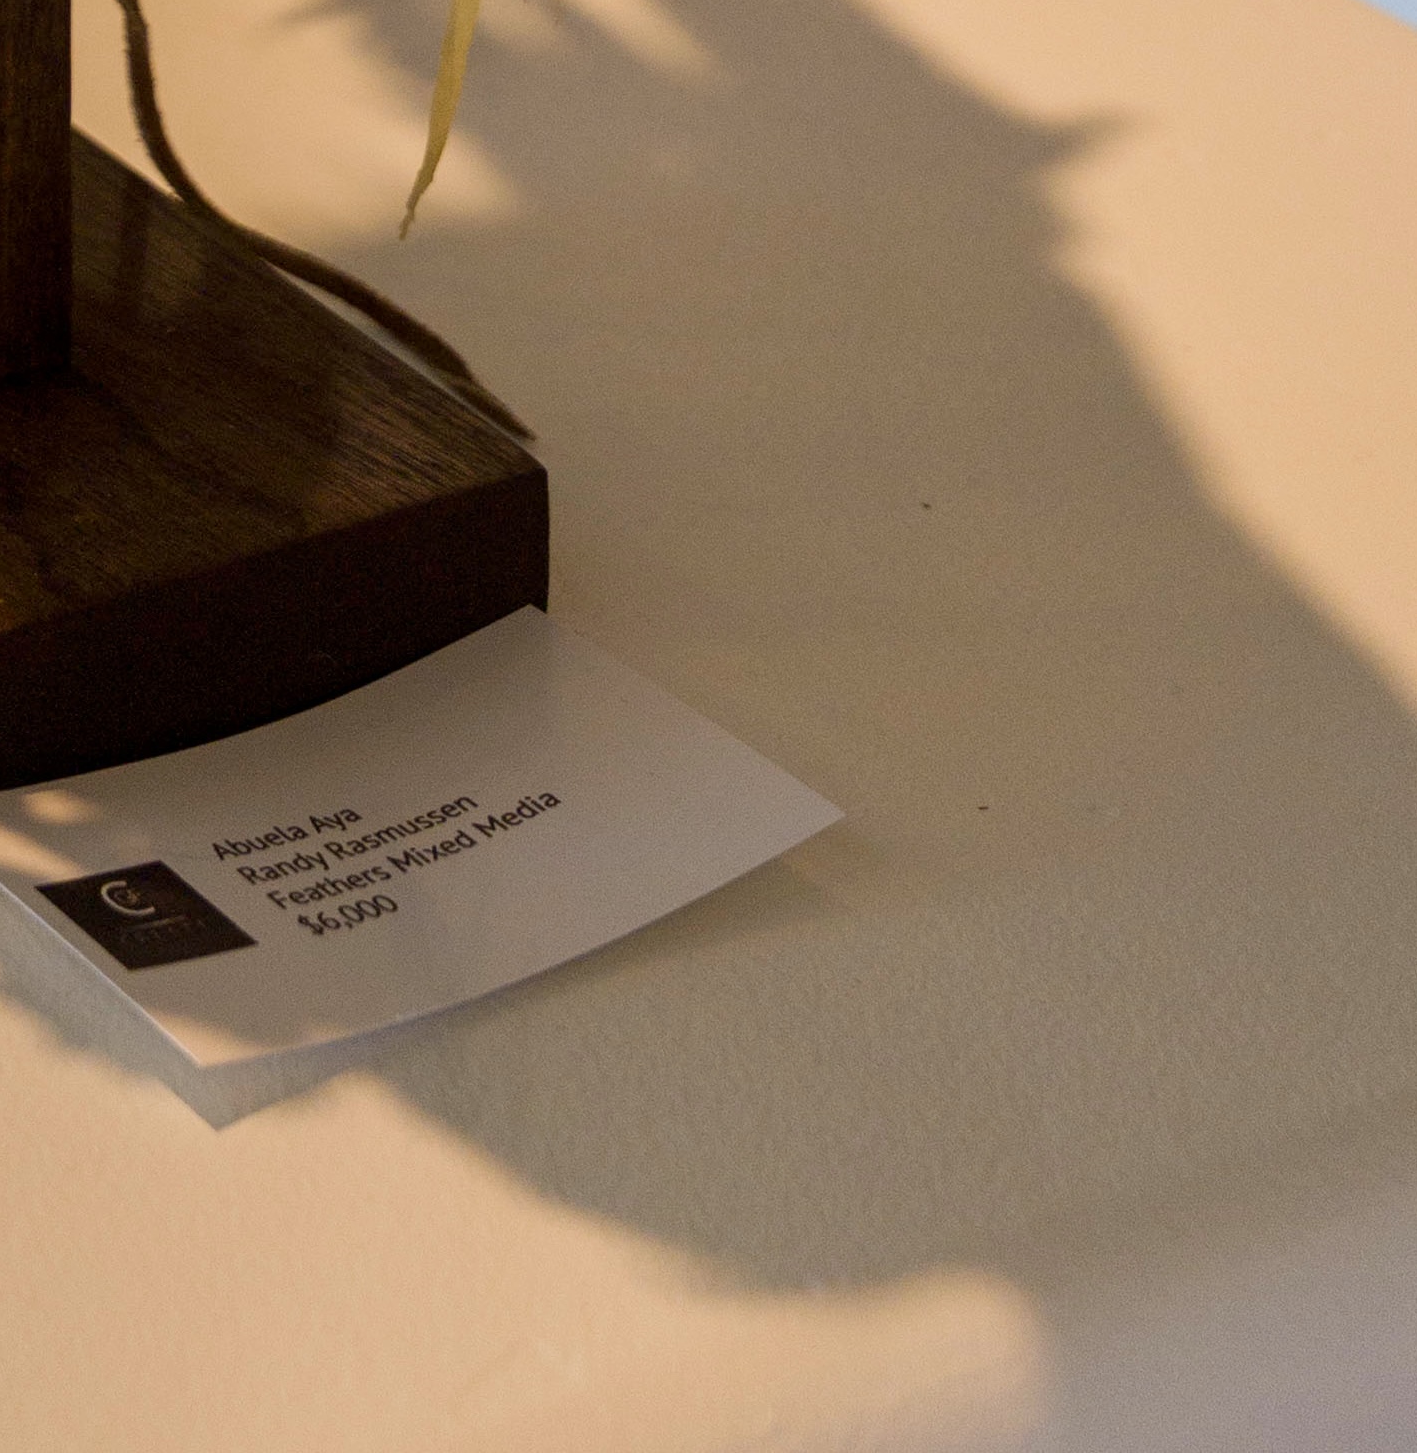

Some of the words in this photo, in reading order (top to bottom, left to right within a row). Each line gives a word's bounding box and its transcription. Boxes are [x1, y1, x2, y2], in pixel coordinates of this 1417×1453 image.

[212, 825, 309, 860] Abuela
[309, 808, 363, 834] Aya
[236, 851, 330, 885] Randy
[324, 795, 479, 860] Rasmussen
[267, 865, 392, 910] Feathers
[386, 829, 479, 873] Mixed
[471, 792, 562, 838] Media
[297, 894, 398, 936] $6,000
